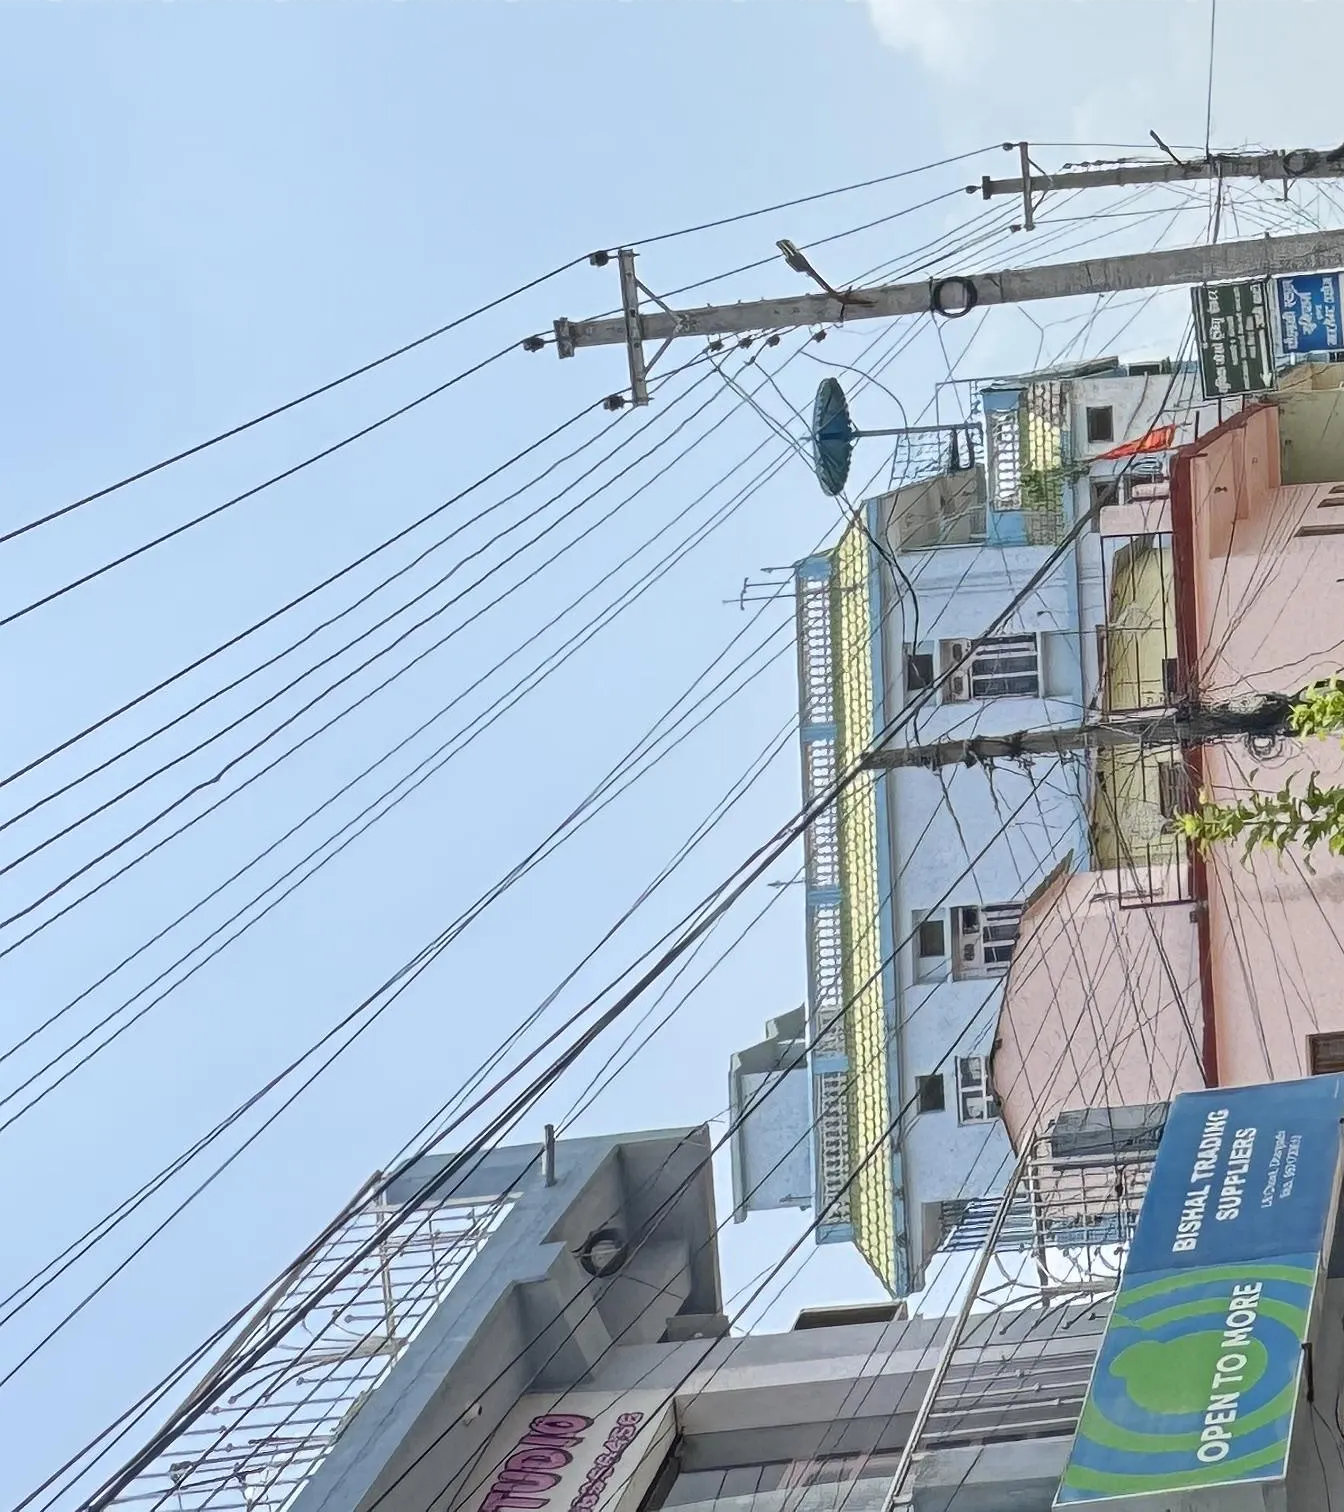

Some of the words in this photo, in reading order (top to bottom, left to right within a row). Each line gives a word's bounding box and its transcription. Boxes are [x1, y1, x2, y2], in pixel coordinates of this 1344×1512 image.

[1191, 1109, 1229, 1183] TRADING
[1216, 1128, 1256, 1220] SUPPLIERS
[1172, 1186, 1211, 1252] BISHAL
[1221, 1282, 1263, 1346] MORE
[1211, 1354, 1246, 1388] TO
[1197, 1393, 1240, 1462] OPEN
